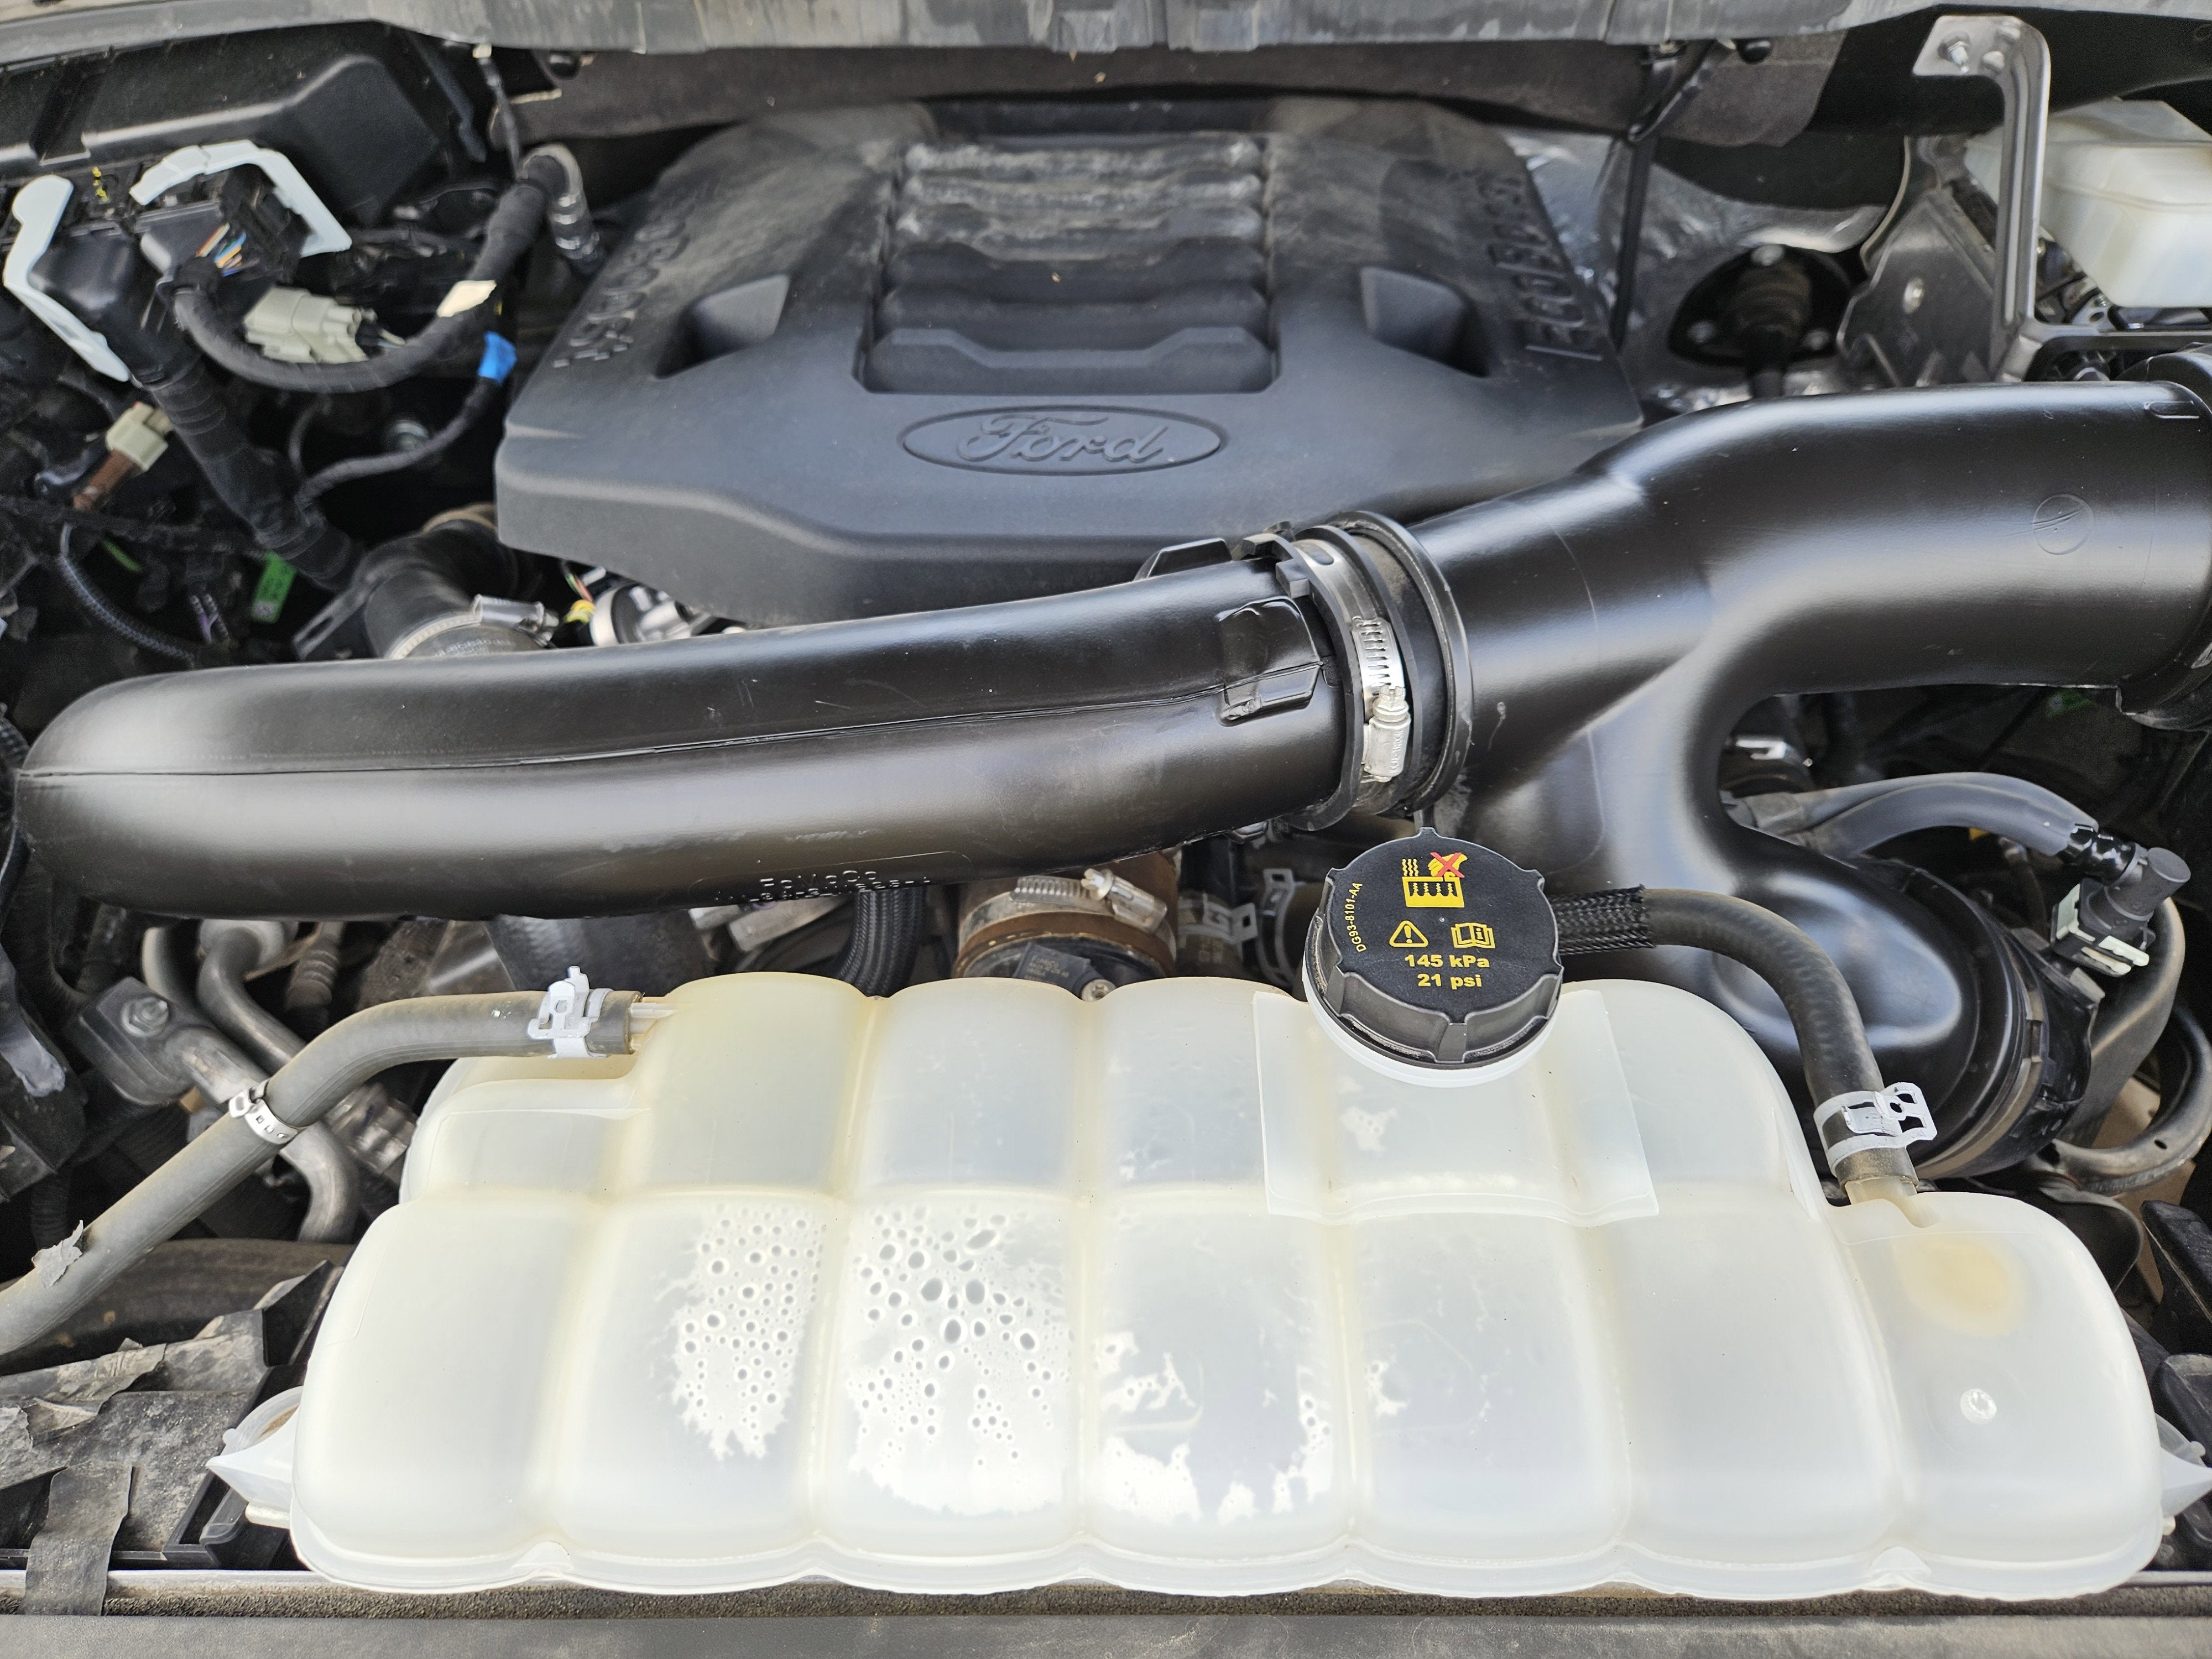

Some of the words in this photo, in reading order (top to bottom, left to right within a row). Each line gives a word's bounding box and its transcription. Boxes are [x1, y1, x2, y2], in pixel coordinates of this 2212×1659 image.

[957, 415, 1169, 463] Ford
[1344, 883, 1367, 952] DG93-8101-AA
[1405, 954, 1443, 967] 145
[1449, 954, 1490, 968] kPa
[1417, 973, 1442, 987] 21
[1450, 974, 1482, 990] psi
